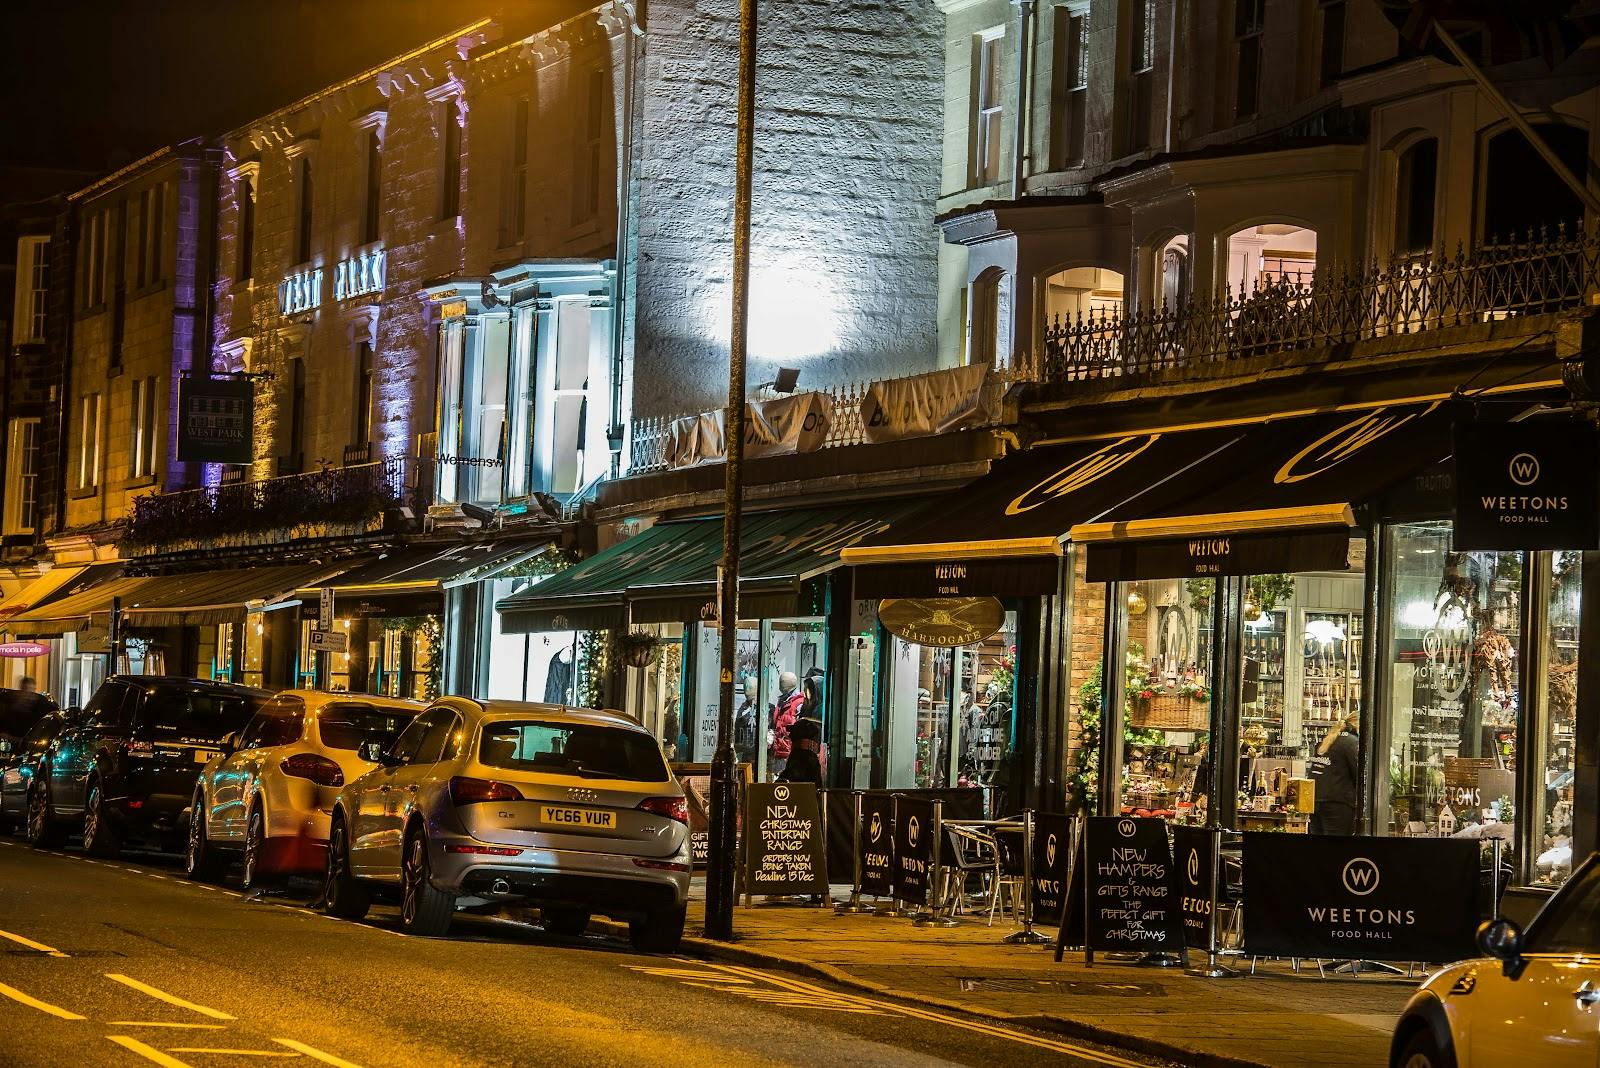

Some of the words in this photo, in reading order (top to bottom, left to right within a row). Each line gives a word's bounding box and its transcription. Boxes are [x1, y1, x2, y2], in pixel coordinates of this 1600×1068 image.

[278, 268, 324, 316] WEST
[333, 250, 387, 302] PARK
[188, 427, 214, 438] WEST
[218, 429, 245, 439] PARK
[1482, 496, 1569, 510] WEETONS
[1500, 515, 1525, 523] FOOD
[1528, 515, 1549, 523] HALL
[1189, 539, 1230, 556] WEETONS
[935, 564, 967, 578] WEETONS
[901, 627, 981, 644] HARROGATE
[546, 808, 581, 824] YC66
[586, 812, 611, 825] VUR
[767, 805, 797, 819] NEW
[760, 819, 812, 831] CHRISTMAS
[762, 830, 810, 840] ENTERTAIN
[767, 840, 803, 851] RANGE
[762, 854, 792, 863] ORDERS
[793, 854, 811, 862] NOW
[1112, 848, 1147, 862] NEW
[762, 862, 784, 871] BEING
[785, 862, 812, 871] TAKEN
[1098, 863, 1165, 879] HAMPERS
[755, 870, 786, 881] Deadline
[799, 871, 815, 881] Dec
[1128, 877, 1136, 885] &
[1097, 885, 1129, 898] GIFTS
[1133, 886, 1168, 897] RANGE
[1123, 901, 1141, 909] THE
[1142, 910, 1166, 920] GIFT
[1308, 907, 1415, 924] WEETONS
[1127, 920, 1144, 929] FOR
[1105, 929, 1166, 942] CHRISTMAS
[1331, 930, 1361, 938] FOOD
[1366, 931, 1393, 939] HALL
